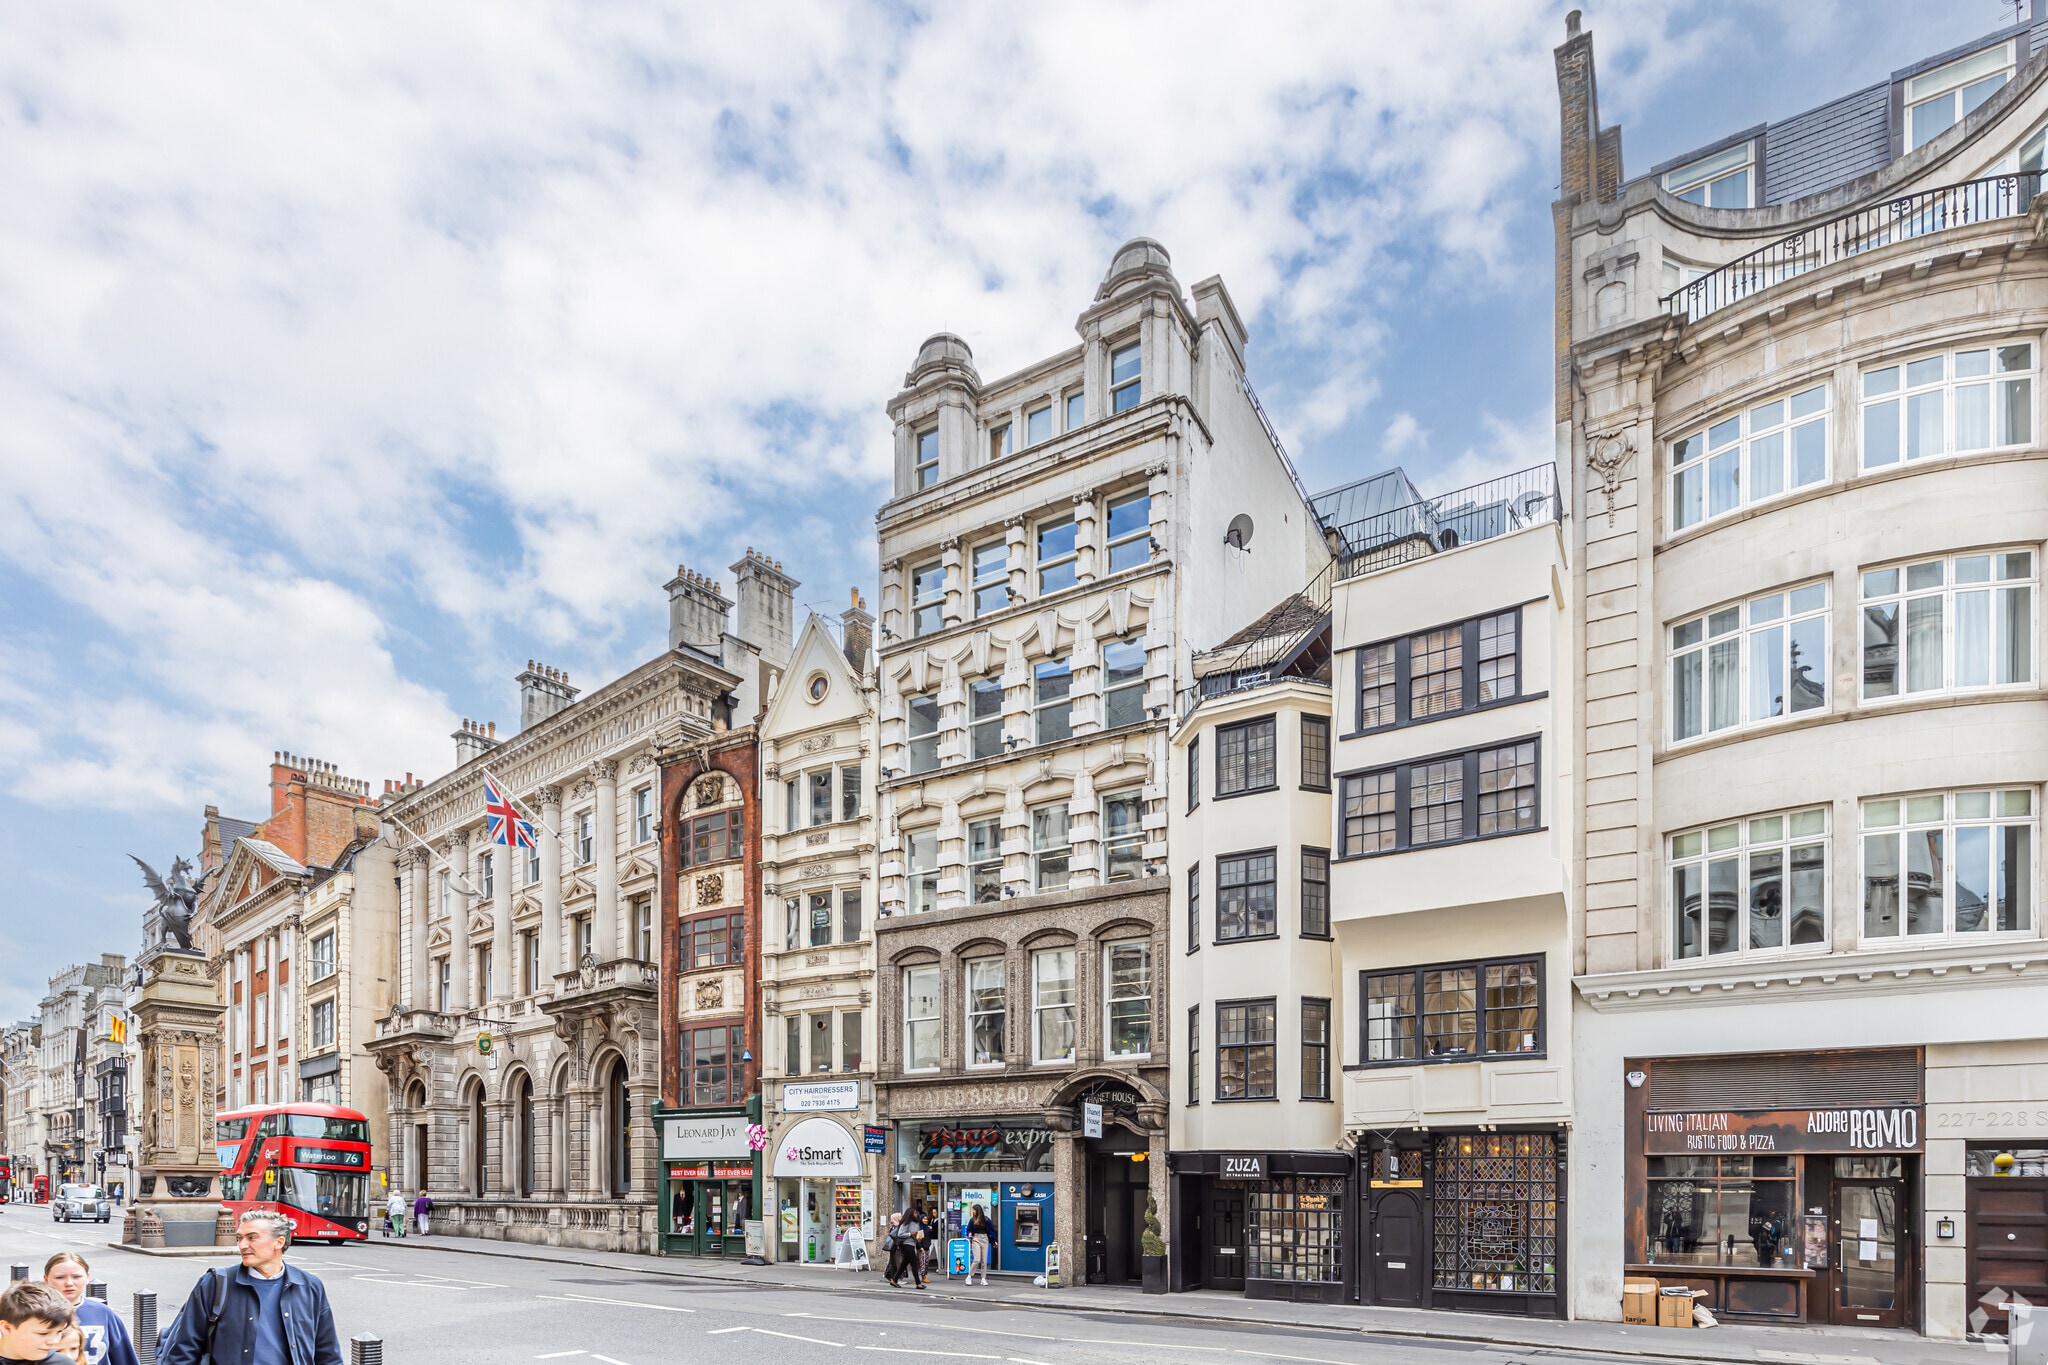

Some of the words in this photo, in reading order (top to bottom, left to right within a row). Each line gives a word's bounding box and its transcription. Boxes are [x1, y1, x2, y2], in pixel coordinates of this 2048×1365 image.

[804, 1085, 853, 1094] HAIRDRESSERS
[826, 1098, 841, 1106] 4175
[1112, 1091, 1136, 1105] HOUSE
[1086, 1107, 1101, 1116] Thanet
[1086, 1117, 1100, 1126] House
[1648, 1113, 1683, 1133] LIVING
[1686, 1113, 1728, 1132] ITALIAN
[1938, 1111, 2028, 1128] 227-228
[677, 1125, 719, 1138] LEONARD
[720, 1124, 737, 1140] JAY
[927, 1128, 998, 1146] TESCO
[1687, 1134, 1716, 1150] RUSTIC
[1717, 1134, 1738, 1150] FOOD
[1740, 1134, 1747, 1150] &
[1749, 1134, 1775, 1150] PIZZA
[344, 1153, 358, 1163] 76
[799, 1146, 841, 1160] tSmart
[1226, 1157, 1260, 1172] ZUZA
[1625, 1316, 1647, 1324] large
